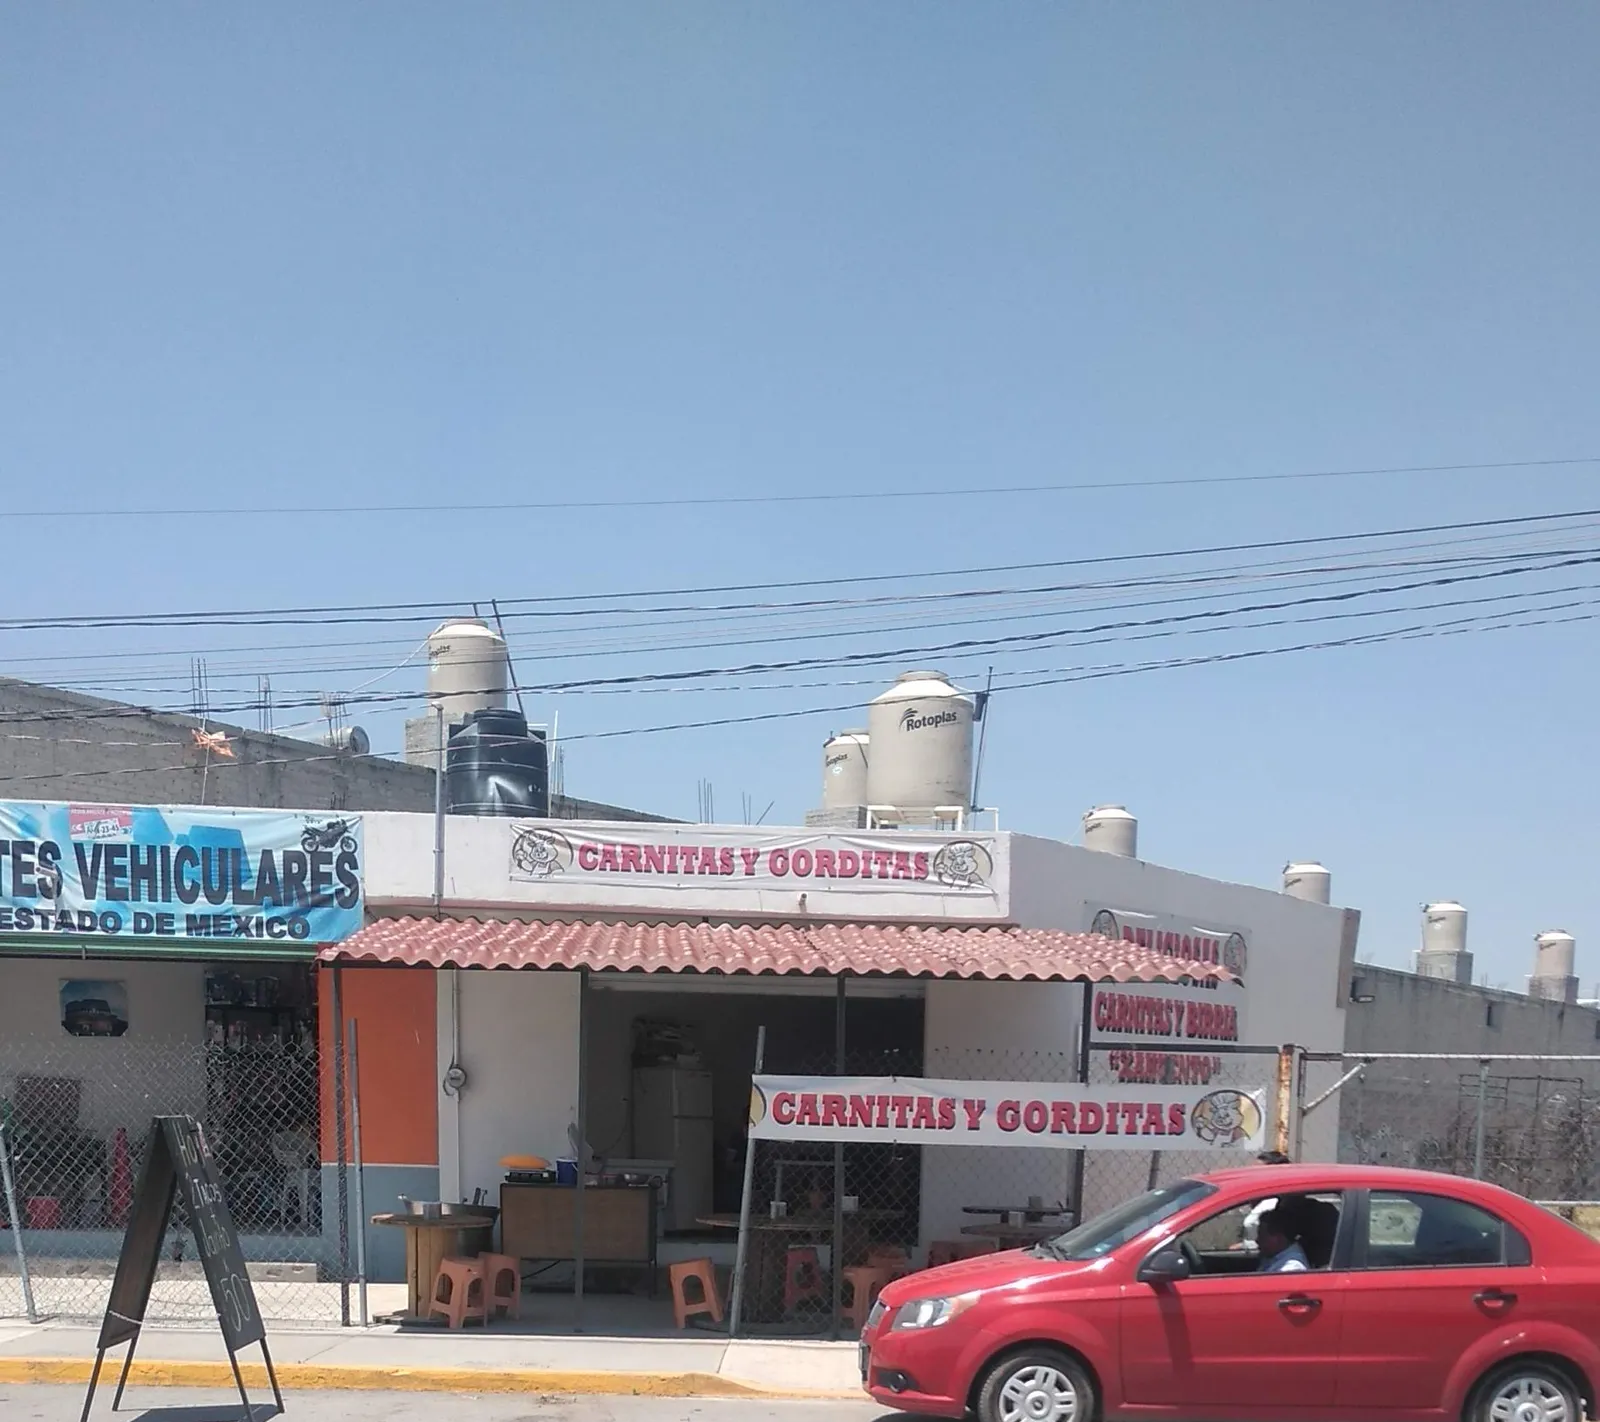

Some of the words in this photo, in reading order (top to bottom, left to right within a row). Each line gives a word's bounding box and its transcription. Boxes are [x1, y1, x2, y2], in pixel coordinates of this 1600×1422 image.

[906, 711, 957, 731] Rotoplas
[73, 842, 359, 909] VEHICULARES
[578, 842, 733, 876] CARNITAS
[735, 847, 760, 876] Y
[769, 848, 930, 881] GORDITAS
[0, 907, 122, 934] ESTADO
[133, 911, 175, 935] DE
[186, 913, 310, 940] MEXICO
[1094, 991, 1173, 1036] CARNITAS
[772, 1091, 956, 1129] CARNITAS
[963, 1098, 986, 1130] Y
[996, 1100, 1186, 1135] GORDITAS
